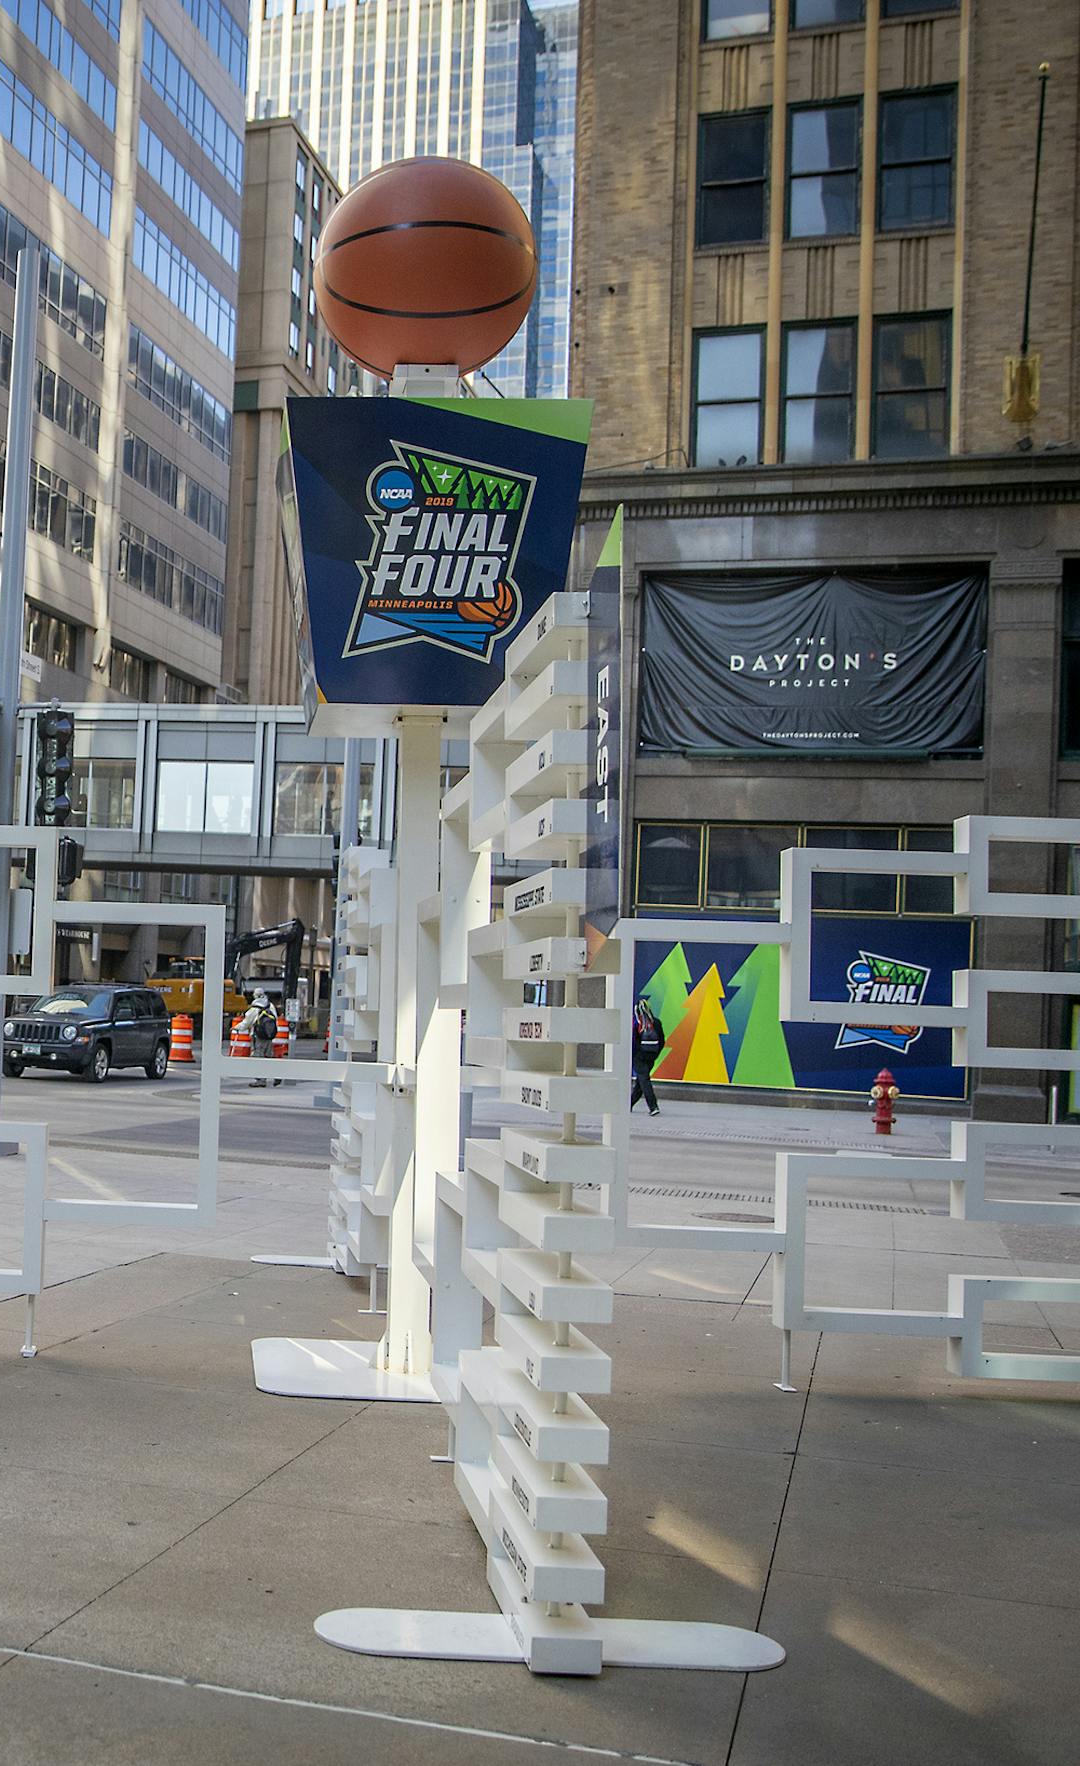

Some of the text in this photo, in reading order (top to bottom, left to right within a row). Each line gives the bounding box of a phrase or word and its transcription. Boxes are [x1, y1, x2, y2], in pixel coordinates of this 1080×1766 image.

[380, 488, 413, 499] NCAA
[425, 497, 454, 506] 2019
[381, 508, 509, 552] FINAL
[370, 554, 503, 598] FOUR
[368, 599, 454, 609] MINNEAPOLIS
[795, 637, 826, 646] THE
[730, 652, 897, 671] DAYTON'S
[769, 678, 851, 687] PROJECT
[596, 665, 610, 823] EAST
[854, 982, 917, 1004] FINAL
